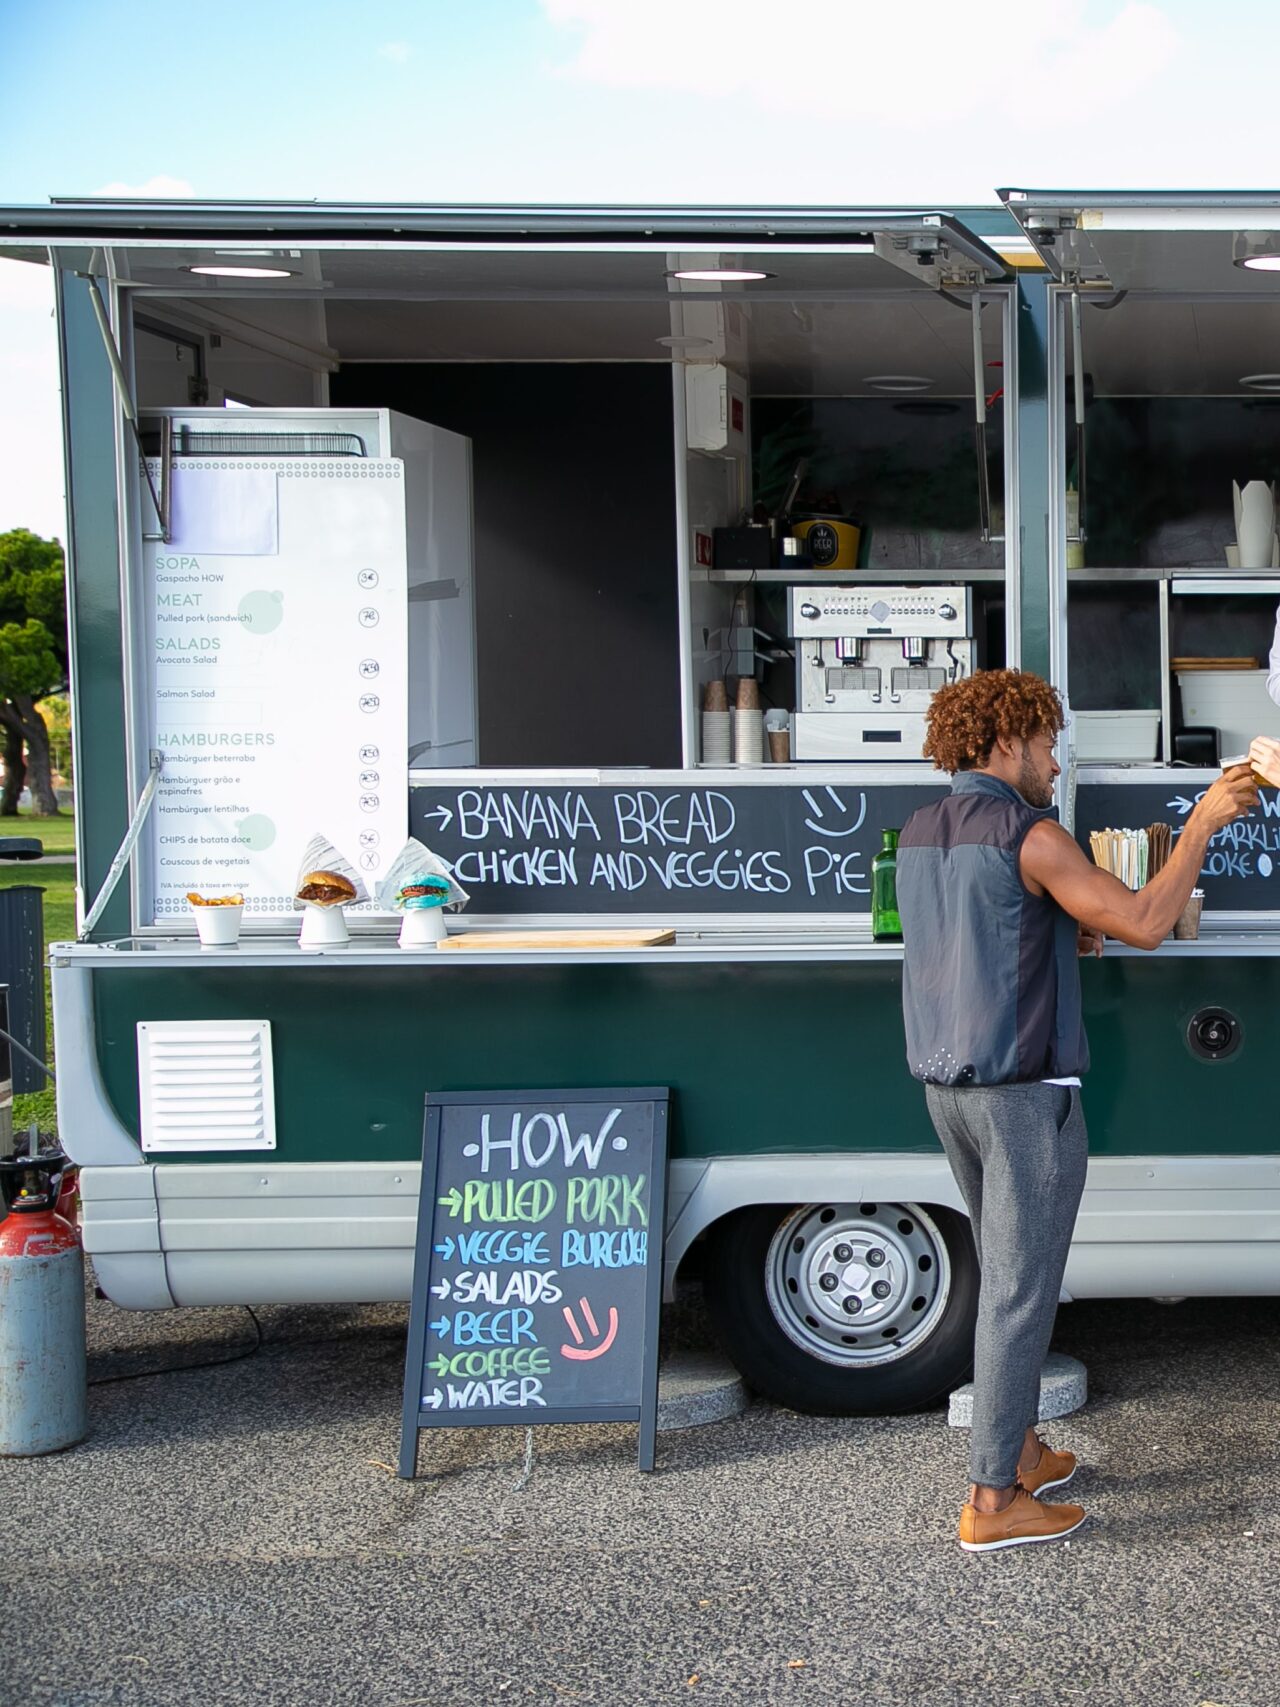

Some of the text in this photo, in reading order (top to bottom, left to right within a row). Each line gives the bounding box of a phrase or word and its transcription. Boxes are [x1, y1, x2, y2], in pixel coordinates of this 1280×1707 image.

[156, 557, 200, 570] SOPA
[156, 574, 224, 584] Gaspacho HOW
[157, 594, 202, 606] MEAT
[157, 614, 253, 623] Pulled pork (sandwich)
[155, 638, 221, 650] SALADS
[193, 656, 217, 664] Salad
[156, 690, 215, 698] Salmon Salad
[157, 733, 275, 746] HAMBURGERS
[213, 754, 255, 762] beterraba
[158, 776, 212, 785] Hambúrguer
[214, 776, 233, 785] grão
[158, 787, 202, 796] espinafres
[158, 805, 250, 815] Hambúrguer lentilhas
[457, 790, 736, 846] BANANA BREAD
[160, 835, 251, 844] CHIPS de batata doce
[160, 857, 250, 867] Couscous de vegetais
[590, 851, 648, 891] AND
[233, 882, 250, 890] vigor
[463, 1174, 649, 1227] PULLED PORK
[561, 1227, 648, 1269] BURGUER
[452, 1270, 563, 1305] SALADS
[453, 1308, 538, 1346] BEER
[449, 1346, 551, 1378] COFFEE
[446, 1376, 548, 1410] WATER
